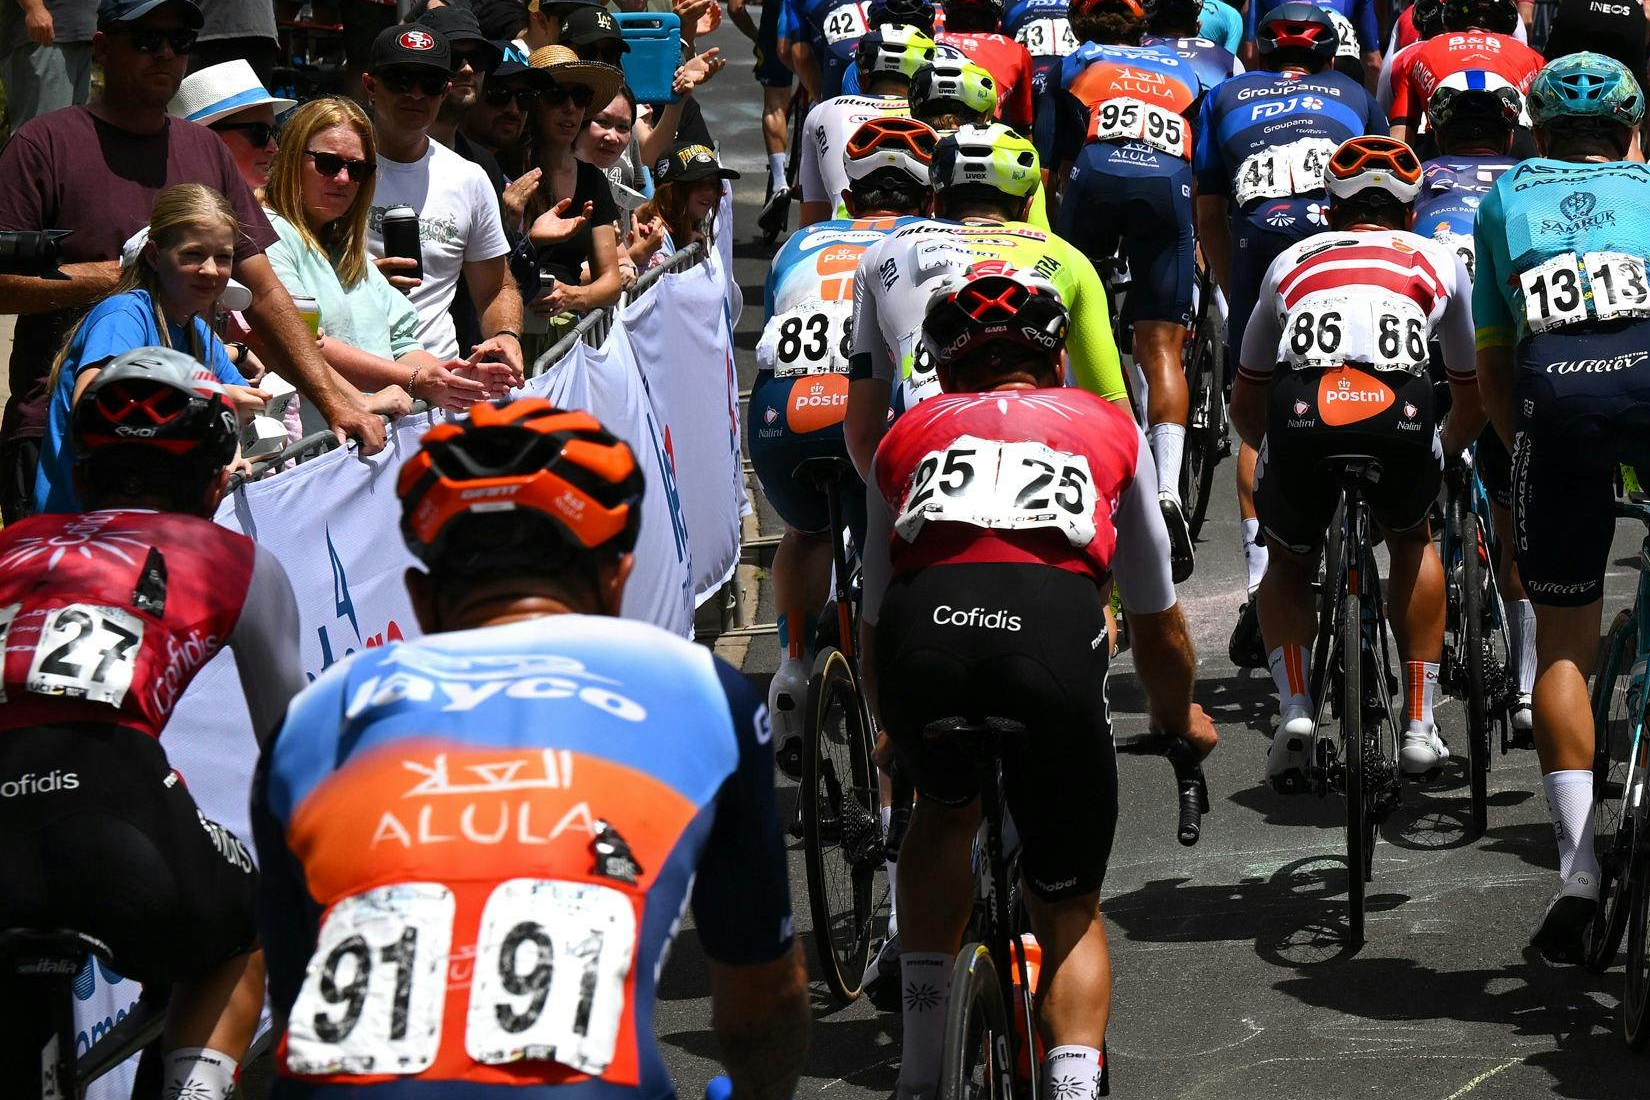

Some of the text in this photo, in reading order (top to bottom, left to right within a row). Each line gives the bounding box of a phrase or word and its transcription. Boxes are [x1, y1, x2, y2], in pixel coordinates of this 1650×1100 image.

[1590, 1, 1631, 16] INEOS
[829, 12, 855, 35] 42
[1449, 36, 1501, 49] B&B
[1449, 44, 1501, 54] HOTELS
[1109, 81, 1174, 101] ALULA
[1238, 84, 1341, 101] Groupama
[1251, 99, 1297, 121] FDJ
[1101, 105, 1181, 146] 95 95
[1264, 117, 1314, 134] Groupama
[1110, 149, 1158, 163] ALULA
[965, 172, 987, 180] uvex
[1244, 157, 1275, 188] 41
[1514, 172, 1648, 193] QAZAQSTAN
[1542, 209, 1616, 234] SAMRUK
[921, 242, 1000, 259] GOBERT
[1529, 262, 1647, 320] 13 13
[778, 313, 829, 364] 83
[1291, 311, 1426, 362] 86 86
[1326, 389, 1384, 404] postnl
[758, 427, 783, 438] Nalini
[1288, 417, 1315, 428] Nalini
[1397, 421, 1423, 431] Nalini
[908, 449, 1088, 515] 25 25
[933, 605, 1023, 632] Cofidis
[38, 608, 140, 686] 27
[345, 670, 649, 723] Jayco
[370, 801, 600, 850] ALULA
[1035, 876, 1079, 893] mobel
[906, 958, 944, 968] mobel
[314, 921, 605, 1044] 91 91
